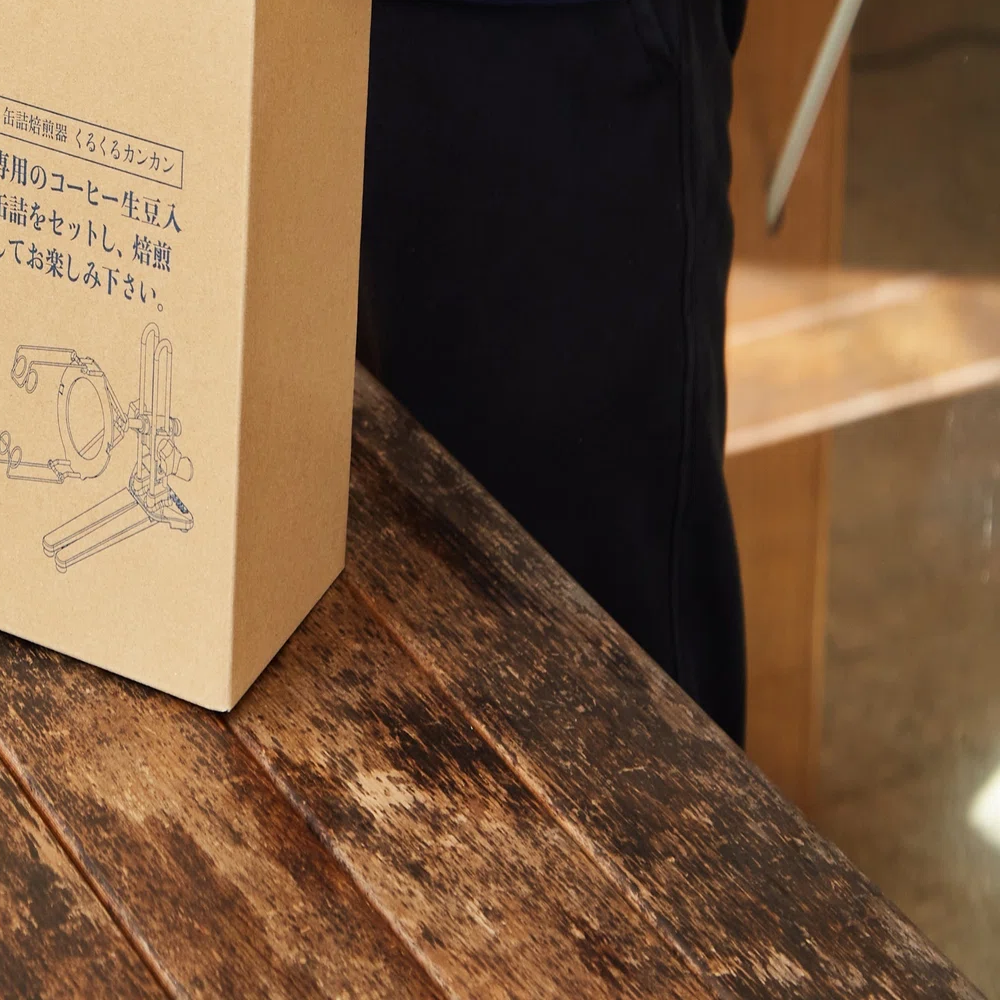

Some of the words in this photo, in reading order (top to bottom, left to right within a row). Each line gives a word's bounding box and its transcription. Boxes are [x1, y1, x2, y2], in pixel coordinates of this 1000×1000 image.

[2, 106, 68, 143] 缶詰焙煎器
[75, 128, 175, 173] くるくるカンカン
